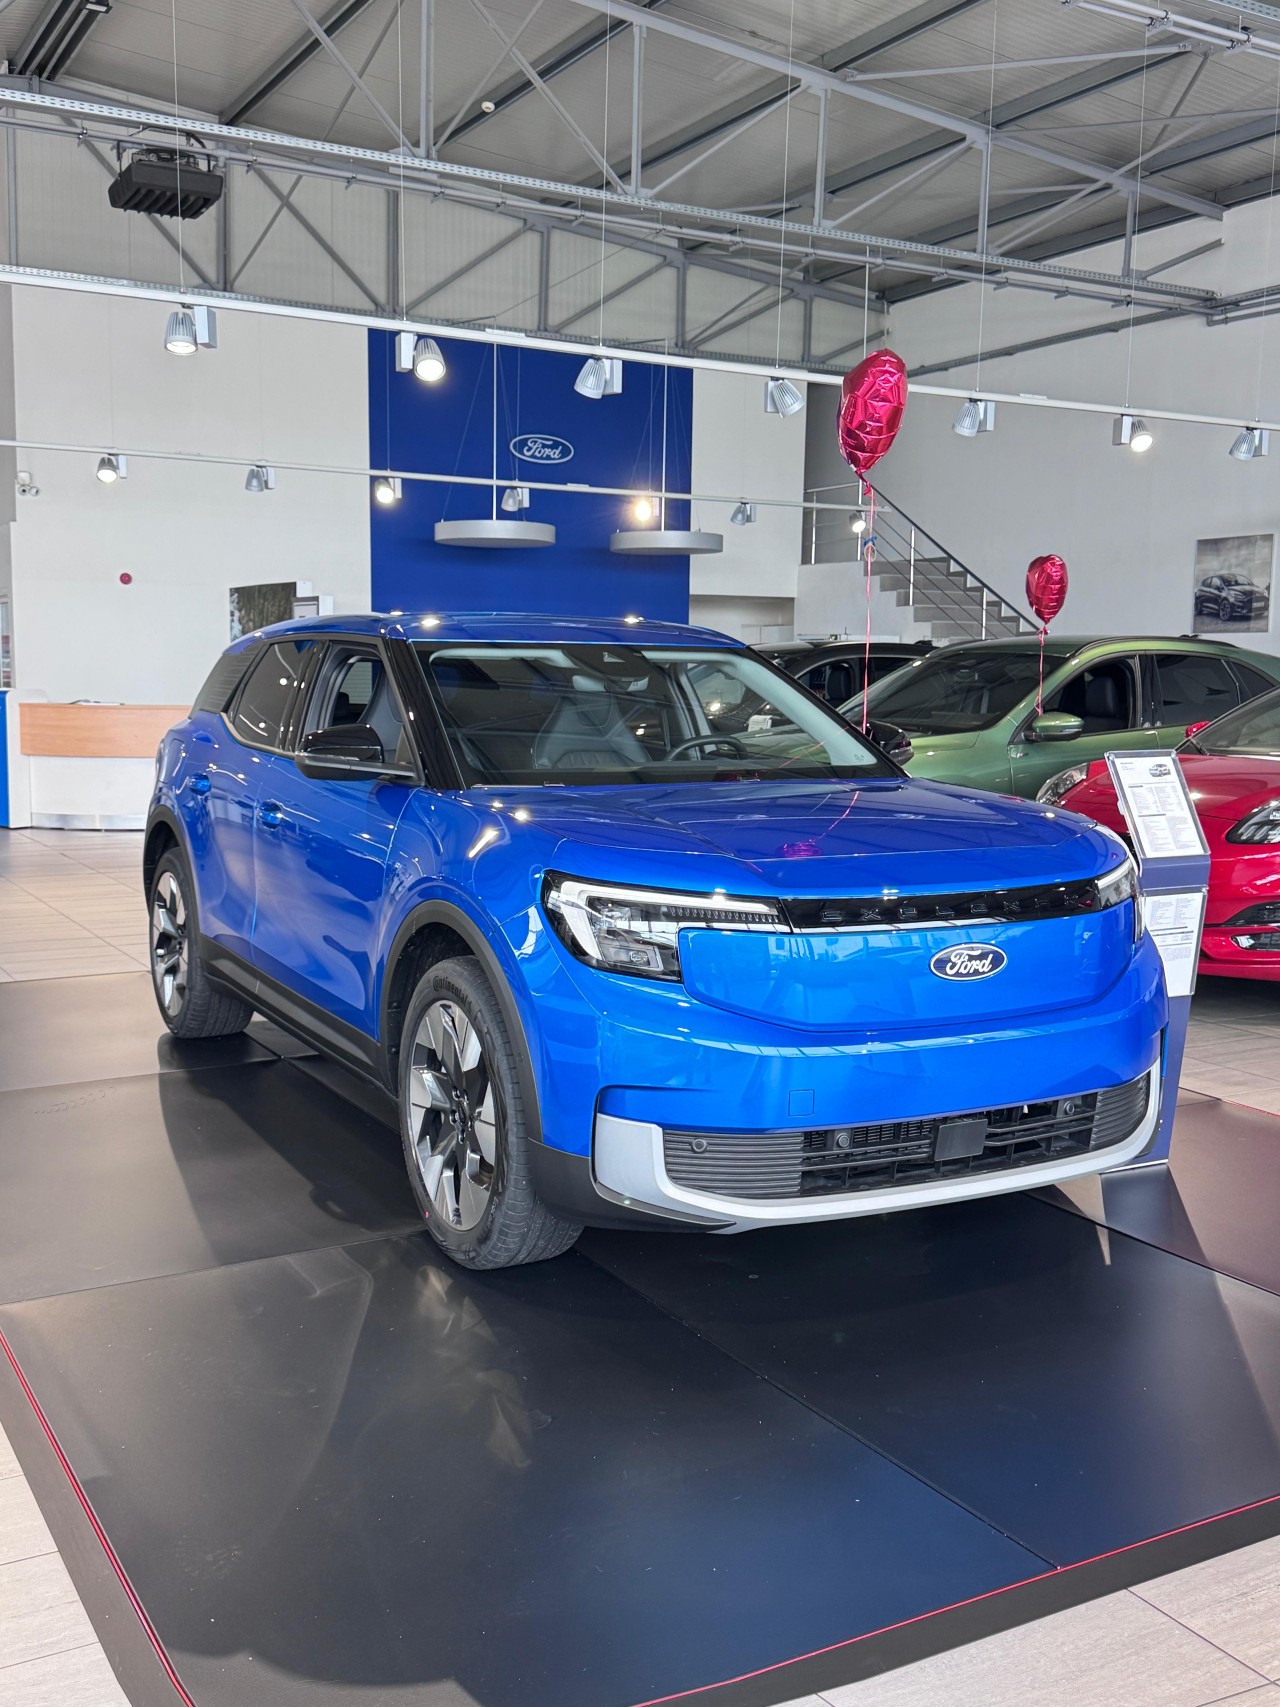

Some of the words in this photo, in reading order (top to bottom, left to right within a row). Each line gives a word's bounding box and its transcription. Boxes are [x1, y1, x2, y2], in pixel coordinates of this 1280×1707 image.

[523, 438, 562, 459] Ford
[945, 949, 993, 975] Ford
[433, 975, 469, 1007] Continental
